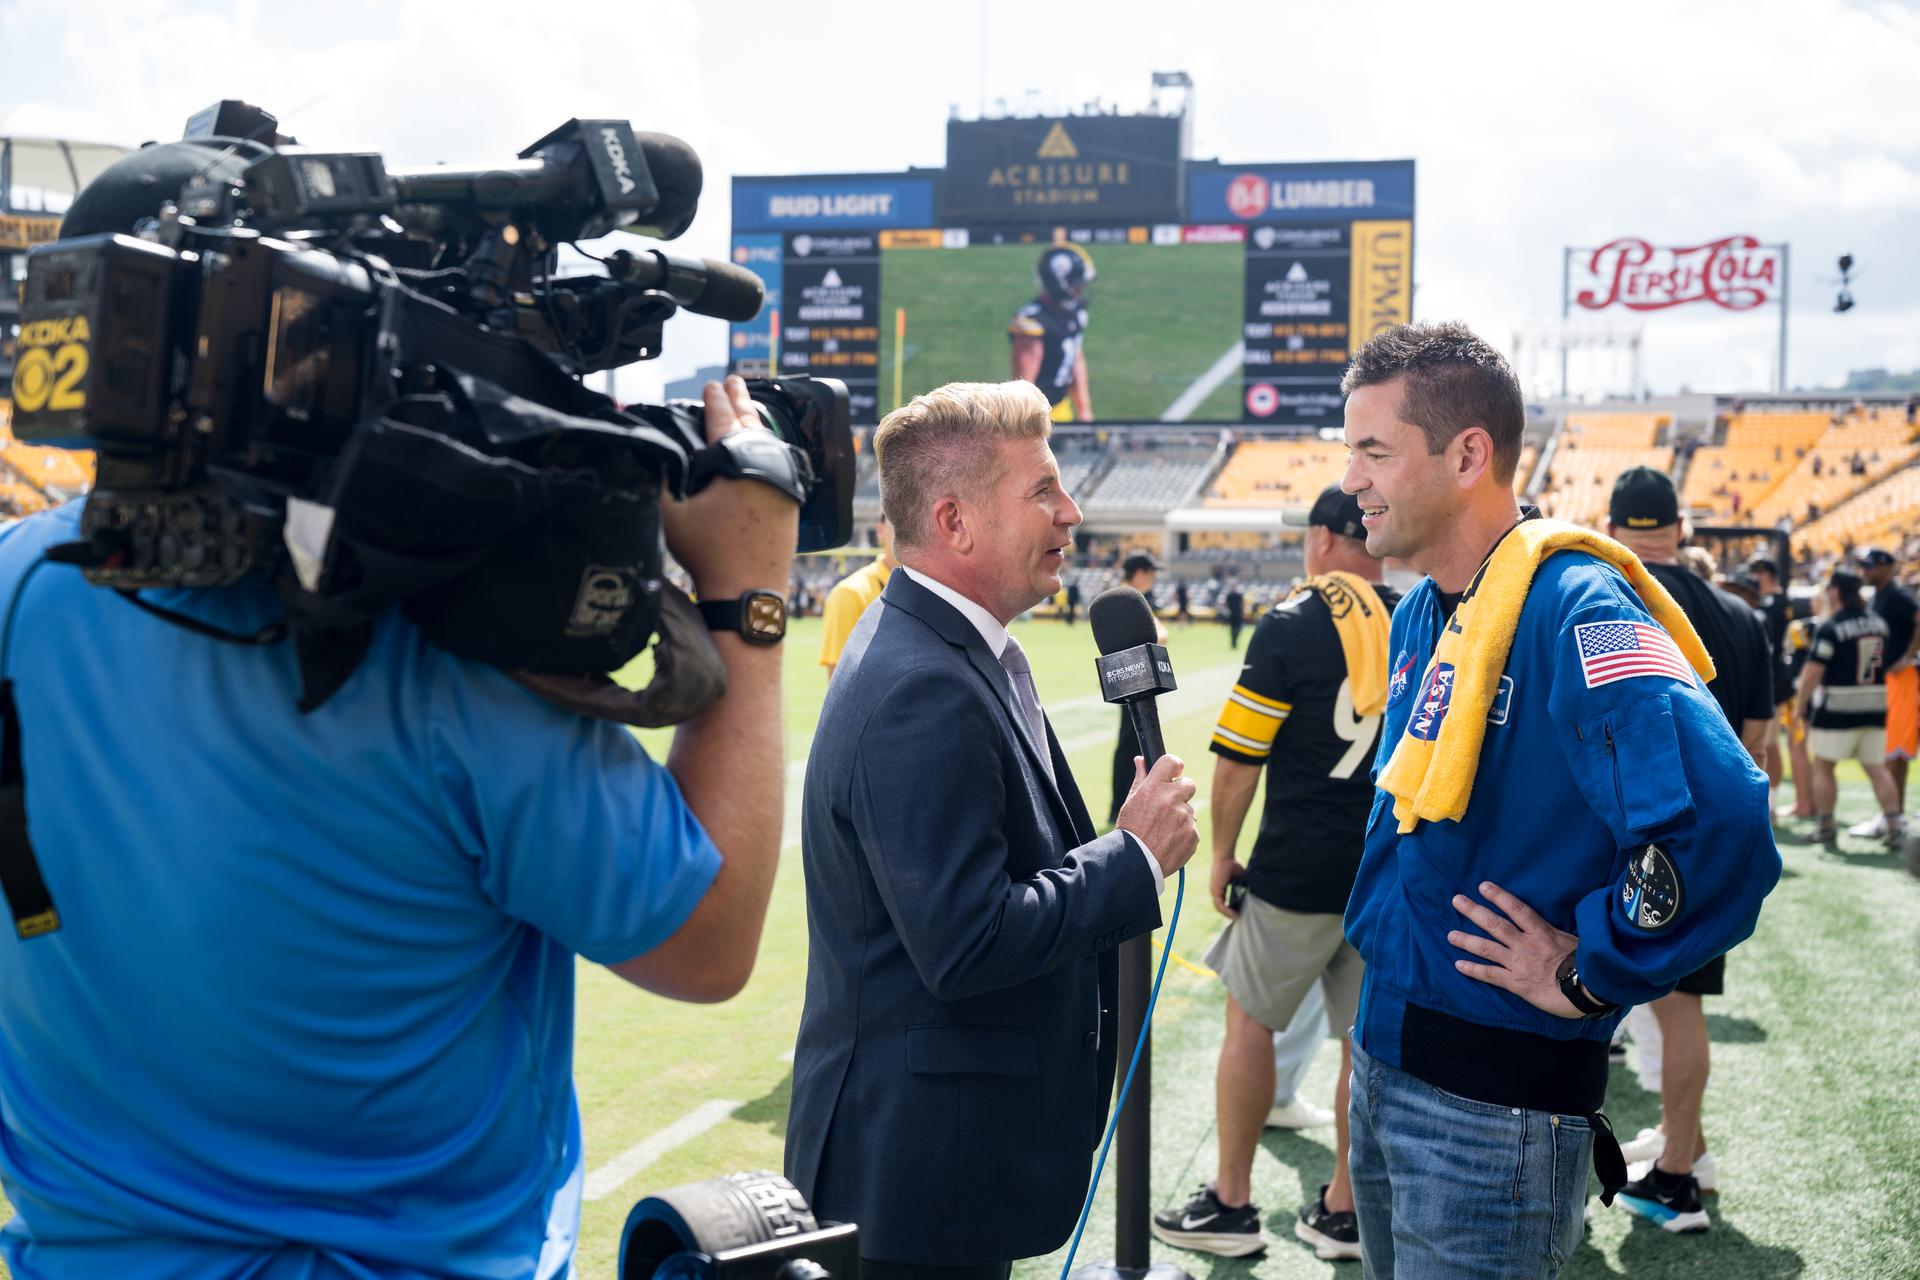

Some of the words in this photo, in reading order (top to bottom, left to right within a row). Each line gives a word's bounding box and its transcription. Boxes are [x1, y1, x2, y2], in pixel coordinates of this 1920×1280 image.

[601, 128, 635, 194] KDKA
[988, 162, 1130, 187] ACRISURE
[769, 195, 821, 217] BUD
[823, 193, 893, 217] LIGHT
[1230, 181, 1265, 209] 84
[1272, 179, 1375, 209] LUMBER
[1108, 668, 1147, 684] PITTSBURGH
[1111, 667, 1125, 677] CBS
[1125, 661, 1145, 674] NEWS
[1414, 669, 1455, 735] NASA
